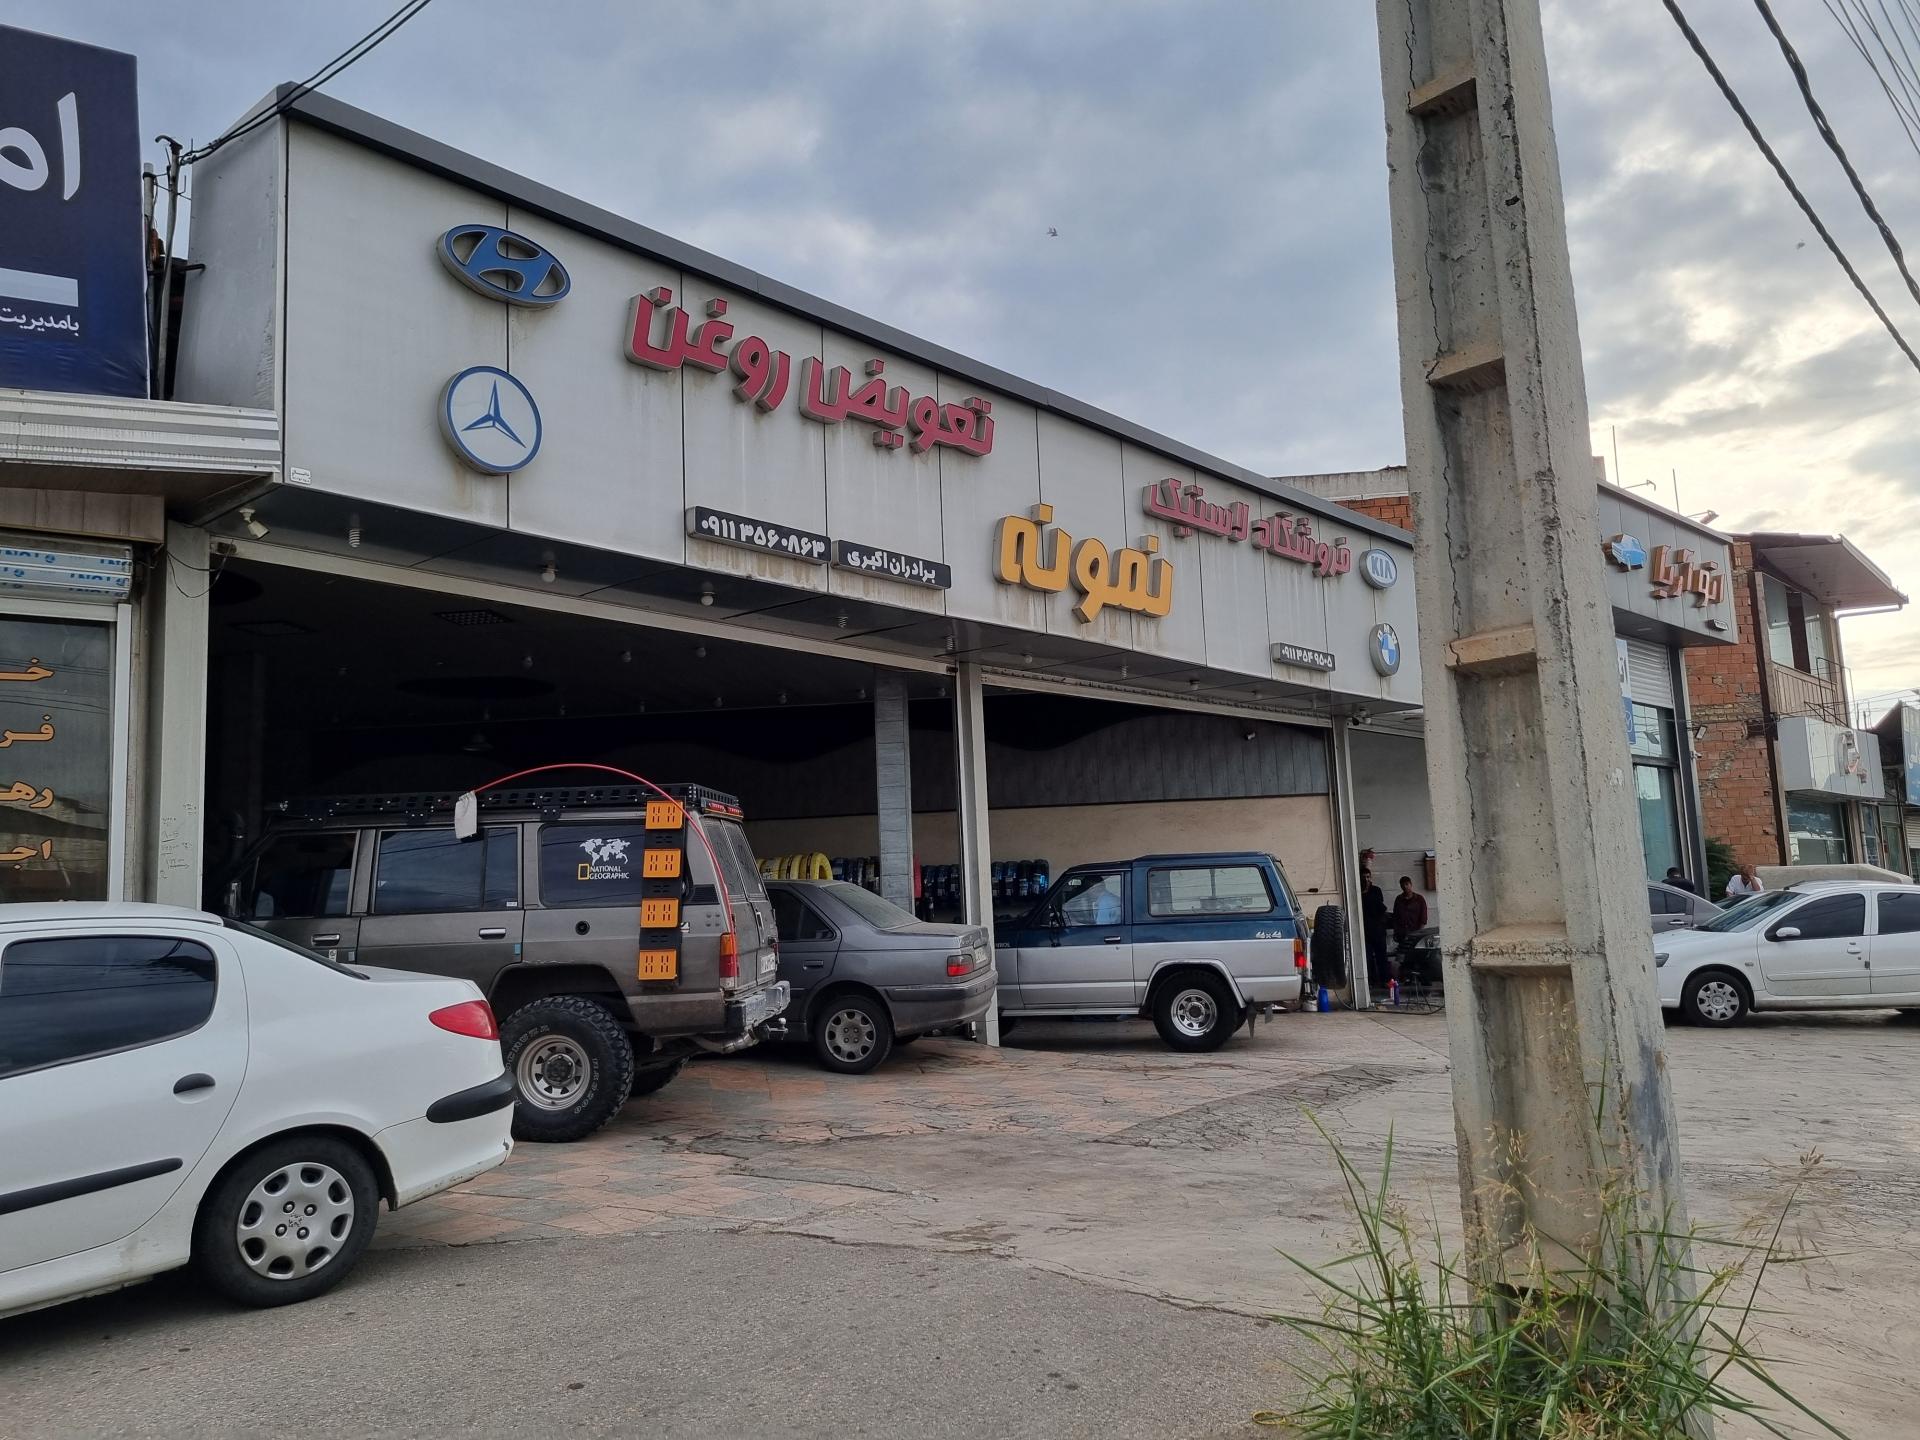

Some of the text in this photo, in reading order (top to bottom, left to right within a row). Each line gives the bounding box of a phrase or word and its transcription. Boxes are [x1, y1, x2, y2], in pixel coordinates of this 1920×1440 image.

[0, 92, 80, 200] ام
[624, 287, 994, 457] تعویض روغن
[1142, 478, 1350, 577] فروشگاه لاستیک
[847, 551, 936, 583] برادران اکبری
[992, 503, 1173, 623] نمونه
[1370, 555, 1393, 580] KIA
[0, 715, 55, 748] فر
[0, 839, 52, 869] اج
[590, 865, 622, 873] NATIONAL
[589, 872, 630, 880] GEOGRAPHIC
